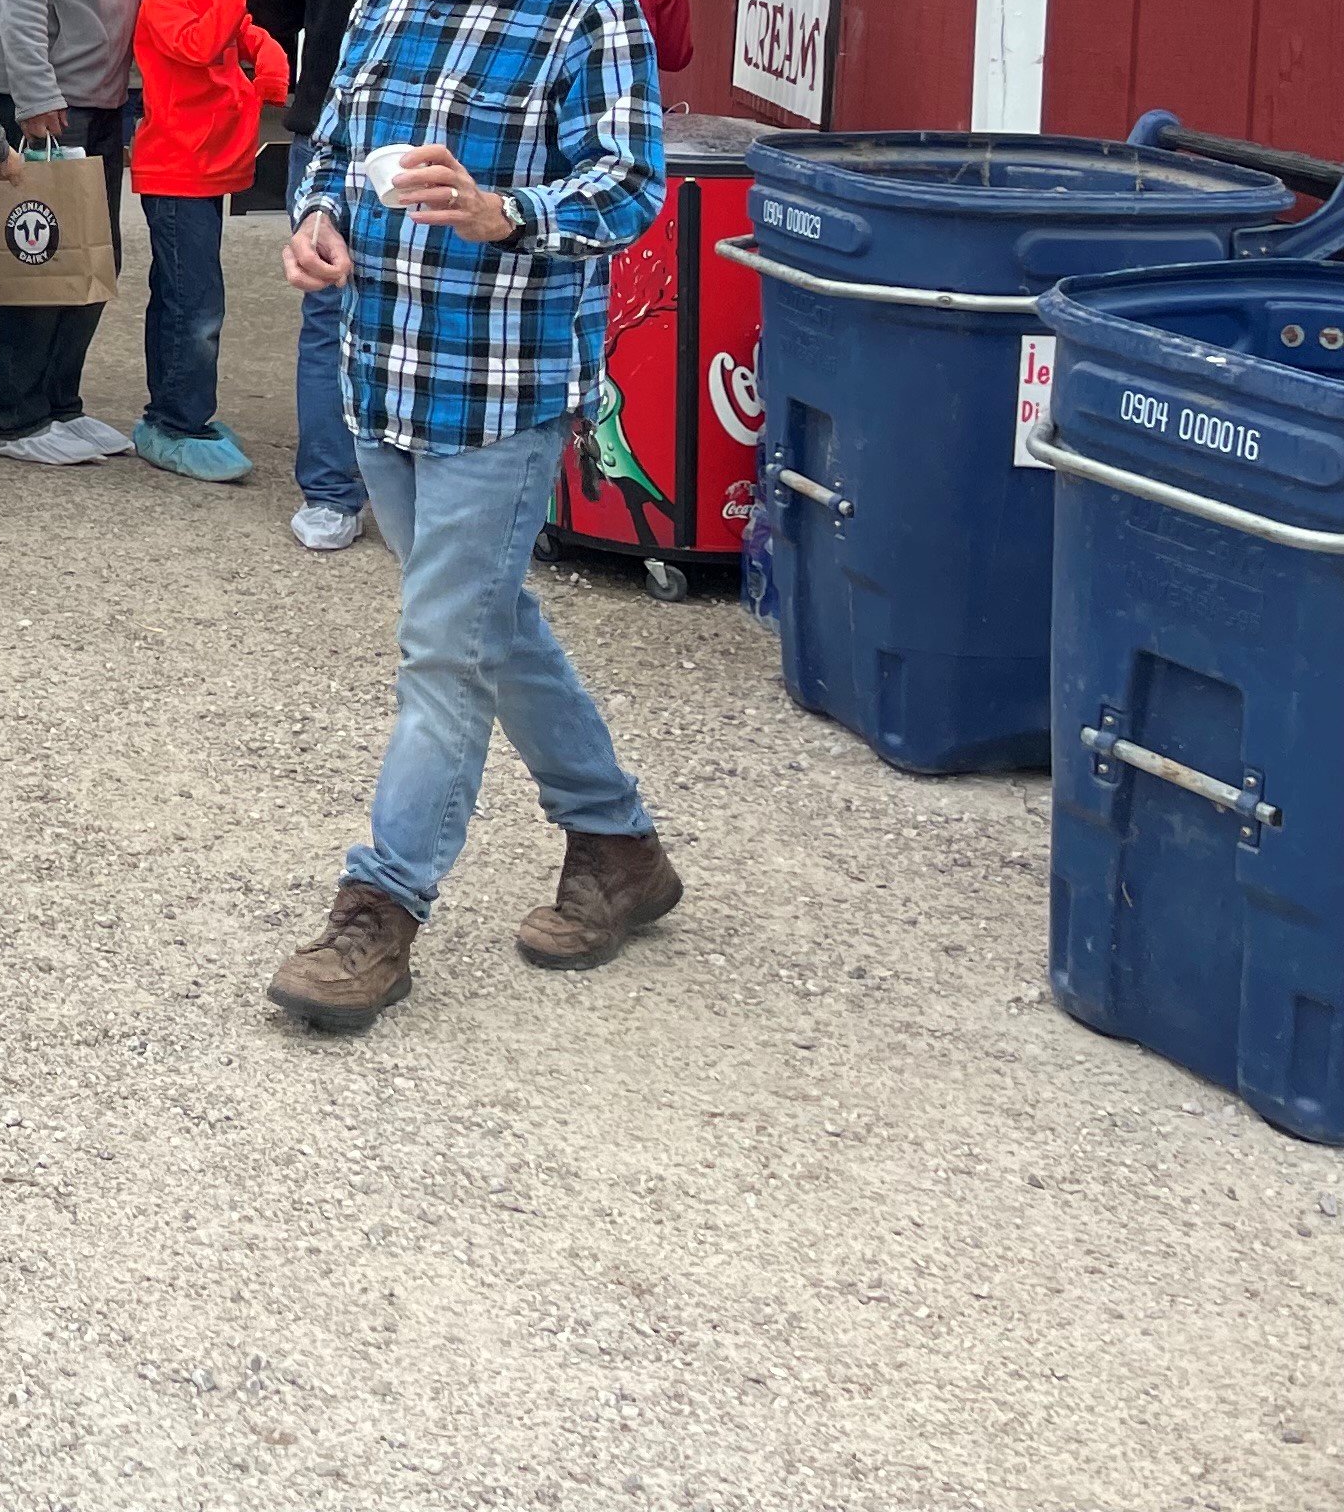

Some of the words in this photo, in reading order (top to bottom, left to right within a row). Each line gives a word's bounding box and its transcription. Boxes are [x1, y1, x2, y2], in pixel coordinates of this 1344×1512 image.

[7, 202, 57, 228] UNDENIABLY
[763, 199, 783, 227] 0904
[786, 207, 821, 239] 000029
[19, 249, 48, 264] DAIRY
[1120, 390, 1169, 433] 0904
[1179, 408, 1261, 461] 000016
